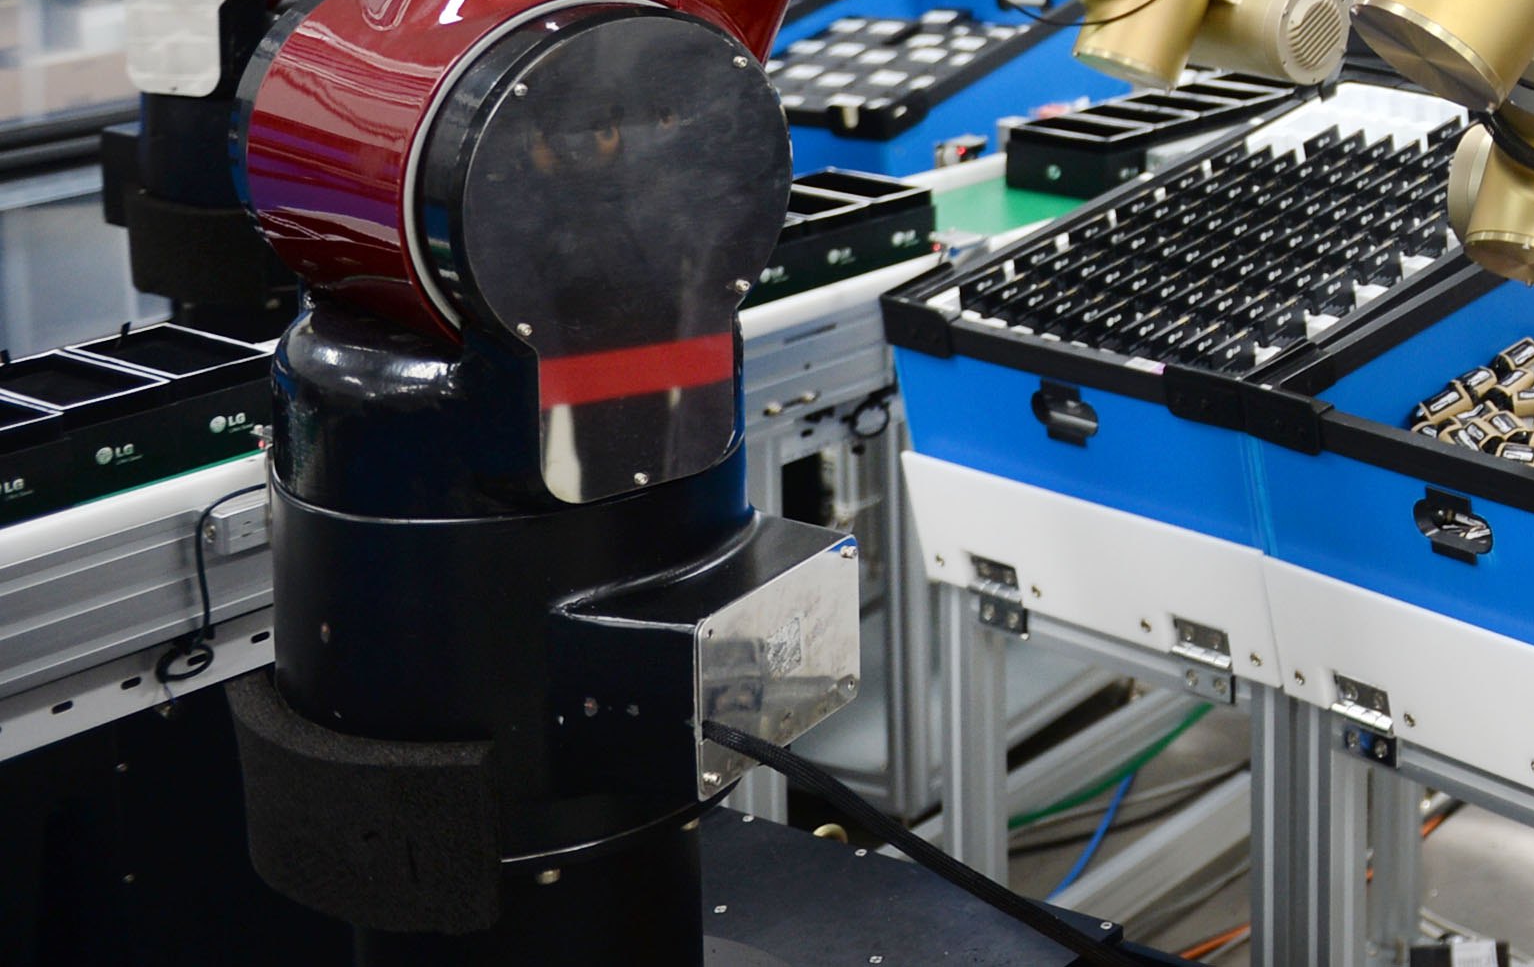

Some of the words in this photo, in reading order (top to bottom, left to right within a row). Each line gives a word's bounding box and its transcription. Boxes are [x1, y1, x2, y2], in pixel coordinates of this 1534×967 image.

[228, 412, 246, 427] LG
[115, 443, 134, 458] LG
[4, 478, 25, 494] LG
